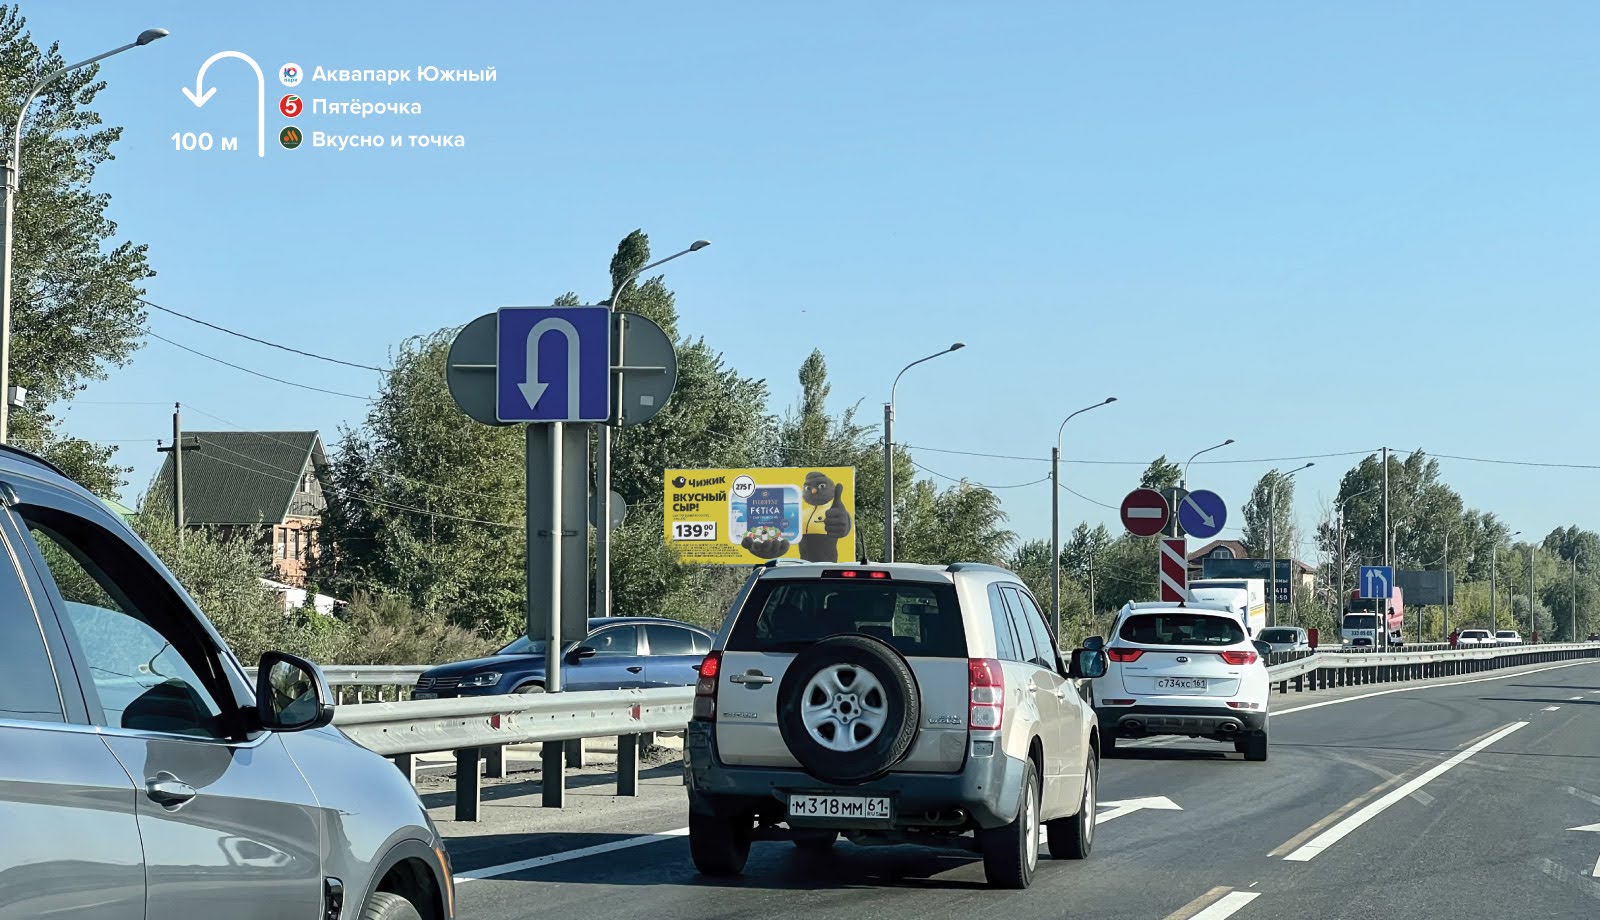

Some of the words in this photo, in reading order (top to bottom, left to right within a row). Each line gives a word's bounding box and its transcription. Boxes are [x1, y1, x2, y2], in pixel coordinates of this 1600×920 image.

[688, 476, 726, 488] Чижик
[673, 490, 726, 502] ВКУСНЫЙ
[673, 503, 699, 512] СЫР!
[675, 524, 703, 538] 139
[1192, 679, 1205, 687] 161
[795, 798, 863, 816] М318ММ
[867, 799, 884, 812] 61
